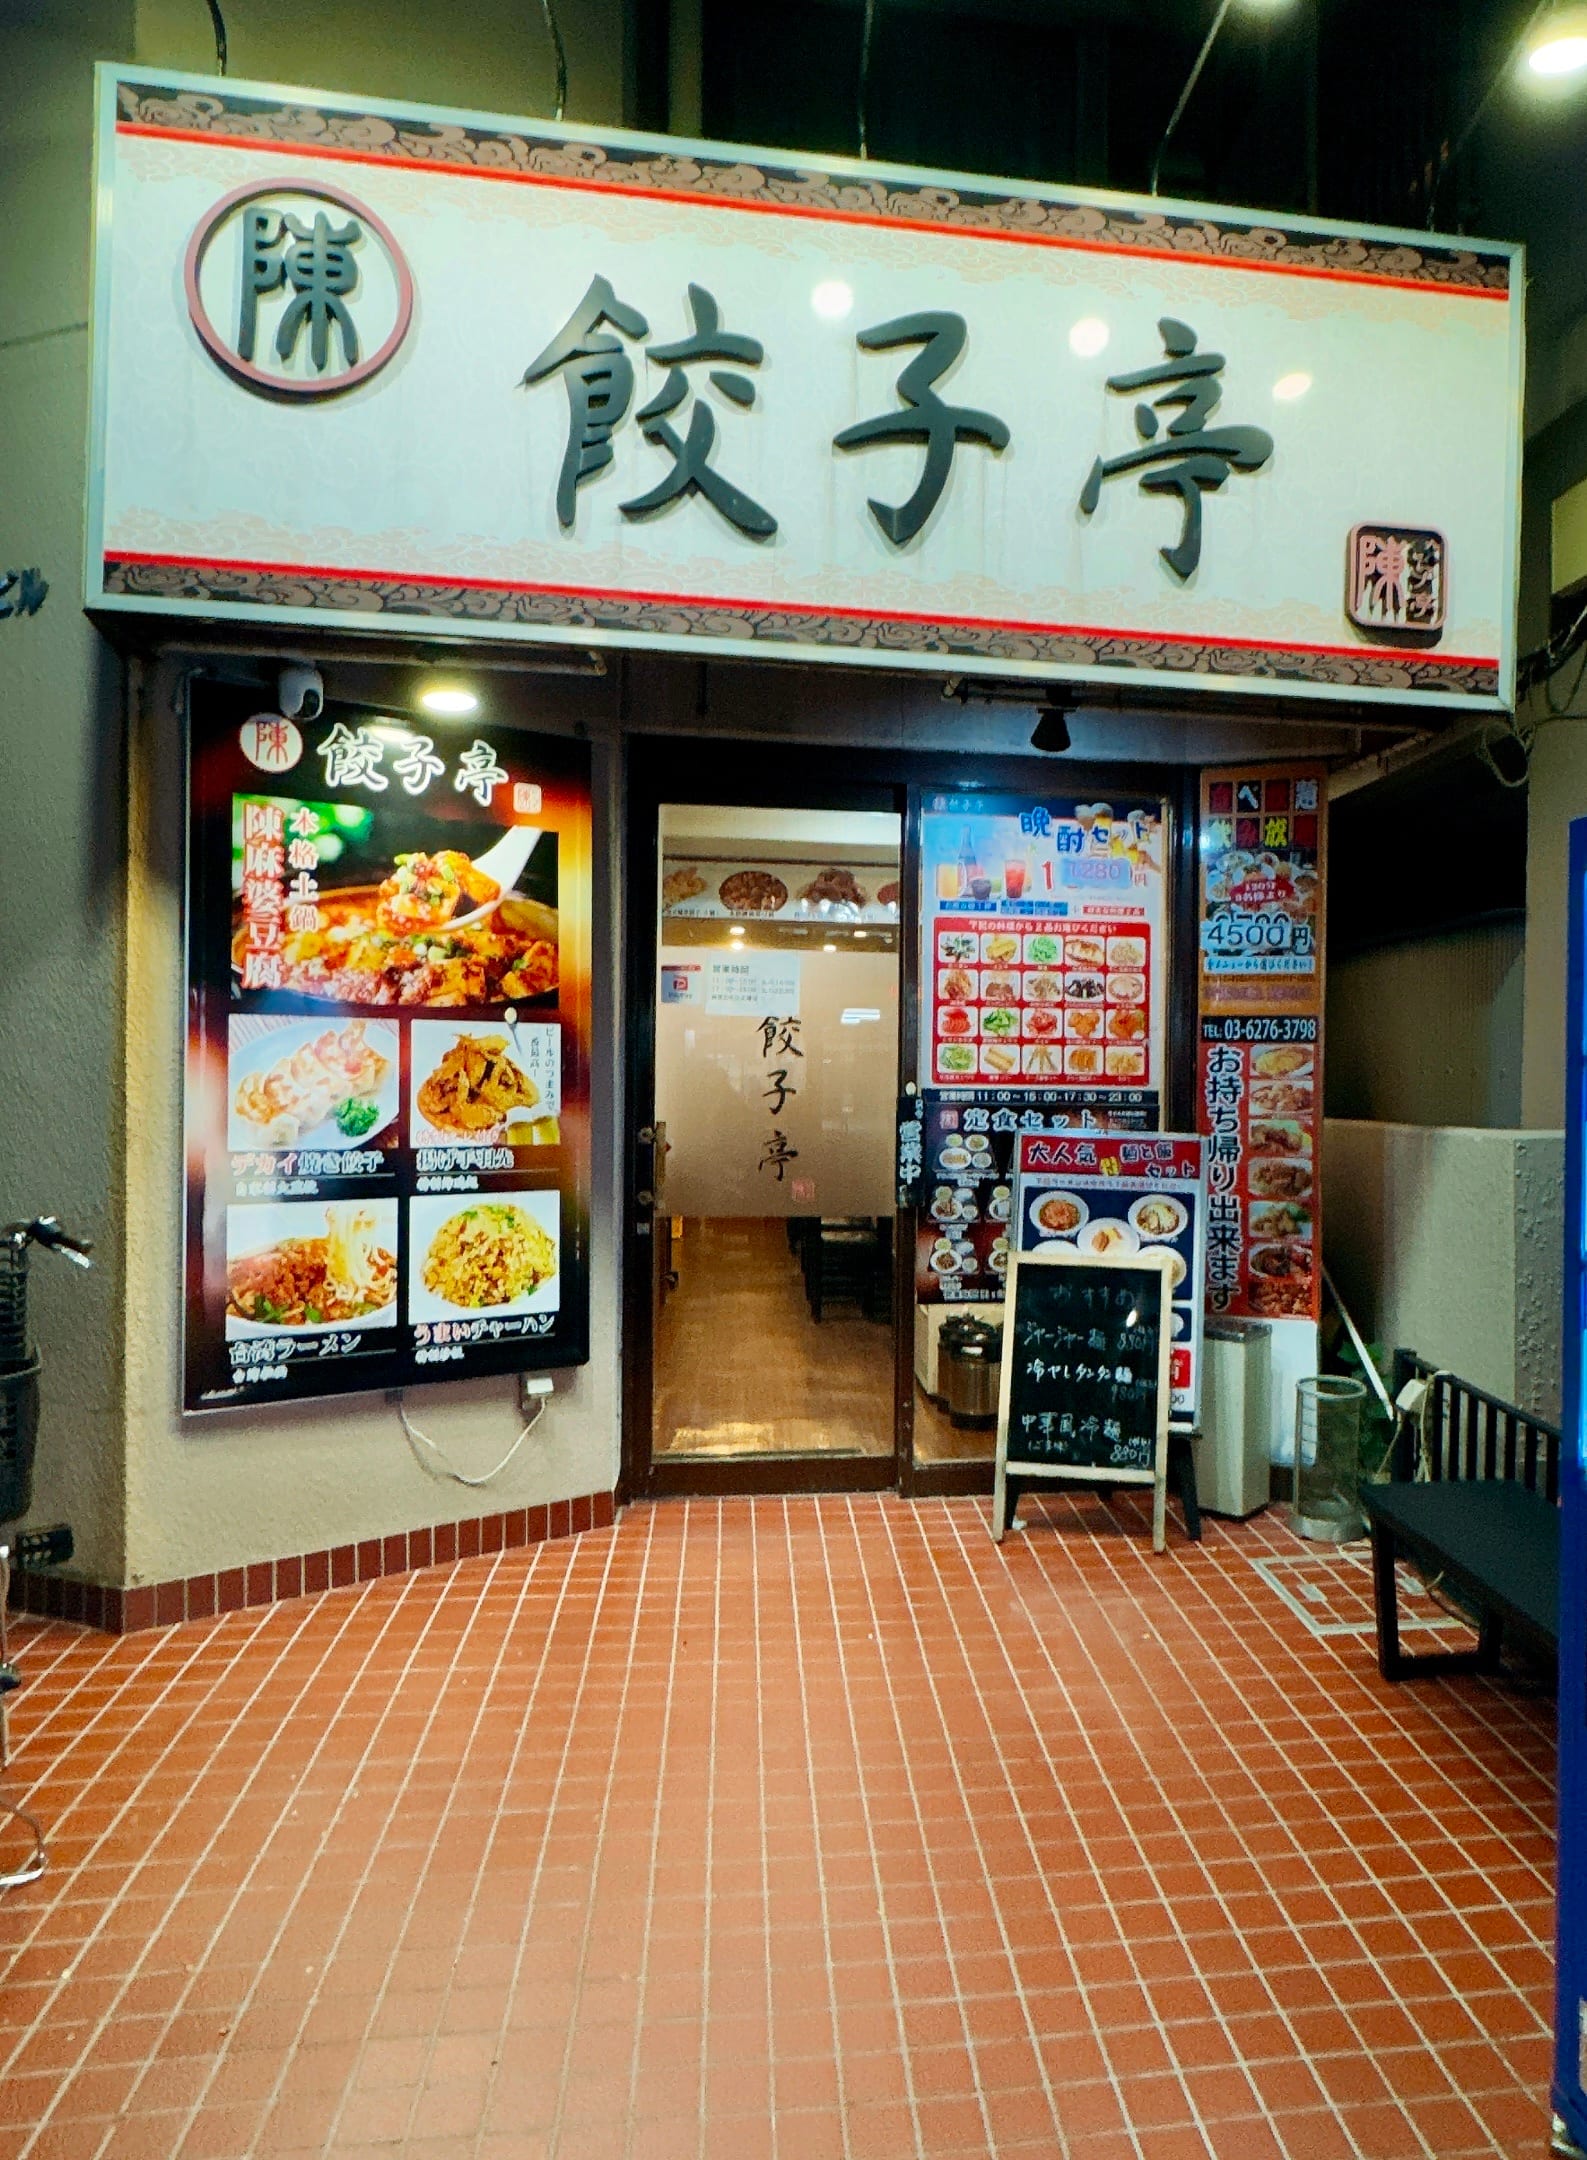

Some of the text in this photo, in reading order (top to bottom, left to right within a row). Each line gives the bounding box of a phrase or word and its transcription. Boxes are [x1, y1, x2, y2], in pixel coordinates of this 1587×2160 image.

[238, 207, 364, 371] 陳
[524, 274, 1274, 580] 餃子亭
[317, 723, 509, 807] 餃子亭
[243, 804, 284, 989] 陳麻婆豆腐
[288, 807, 320, 933] 本格土鍋
[756, 1016, 805, 1181] 餃子亭
[899, 1119, 923, 1185] 営業中
[963, 1108, 1098, 1133] 定食セット
[1028, 1141, 1097, 1166] 大人気
[1207, 1044, 1243, 1312] お持ち帰り出来ます
[413, 1313, 555, 1348] うまいチャーハン
